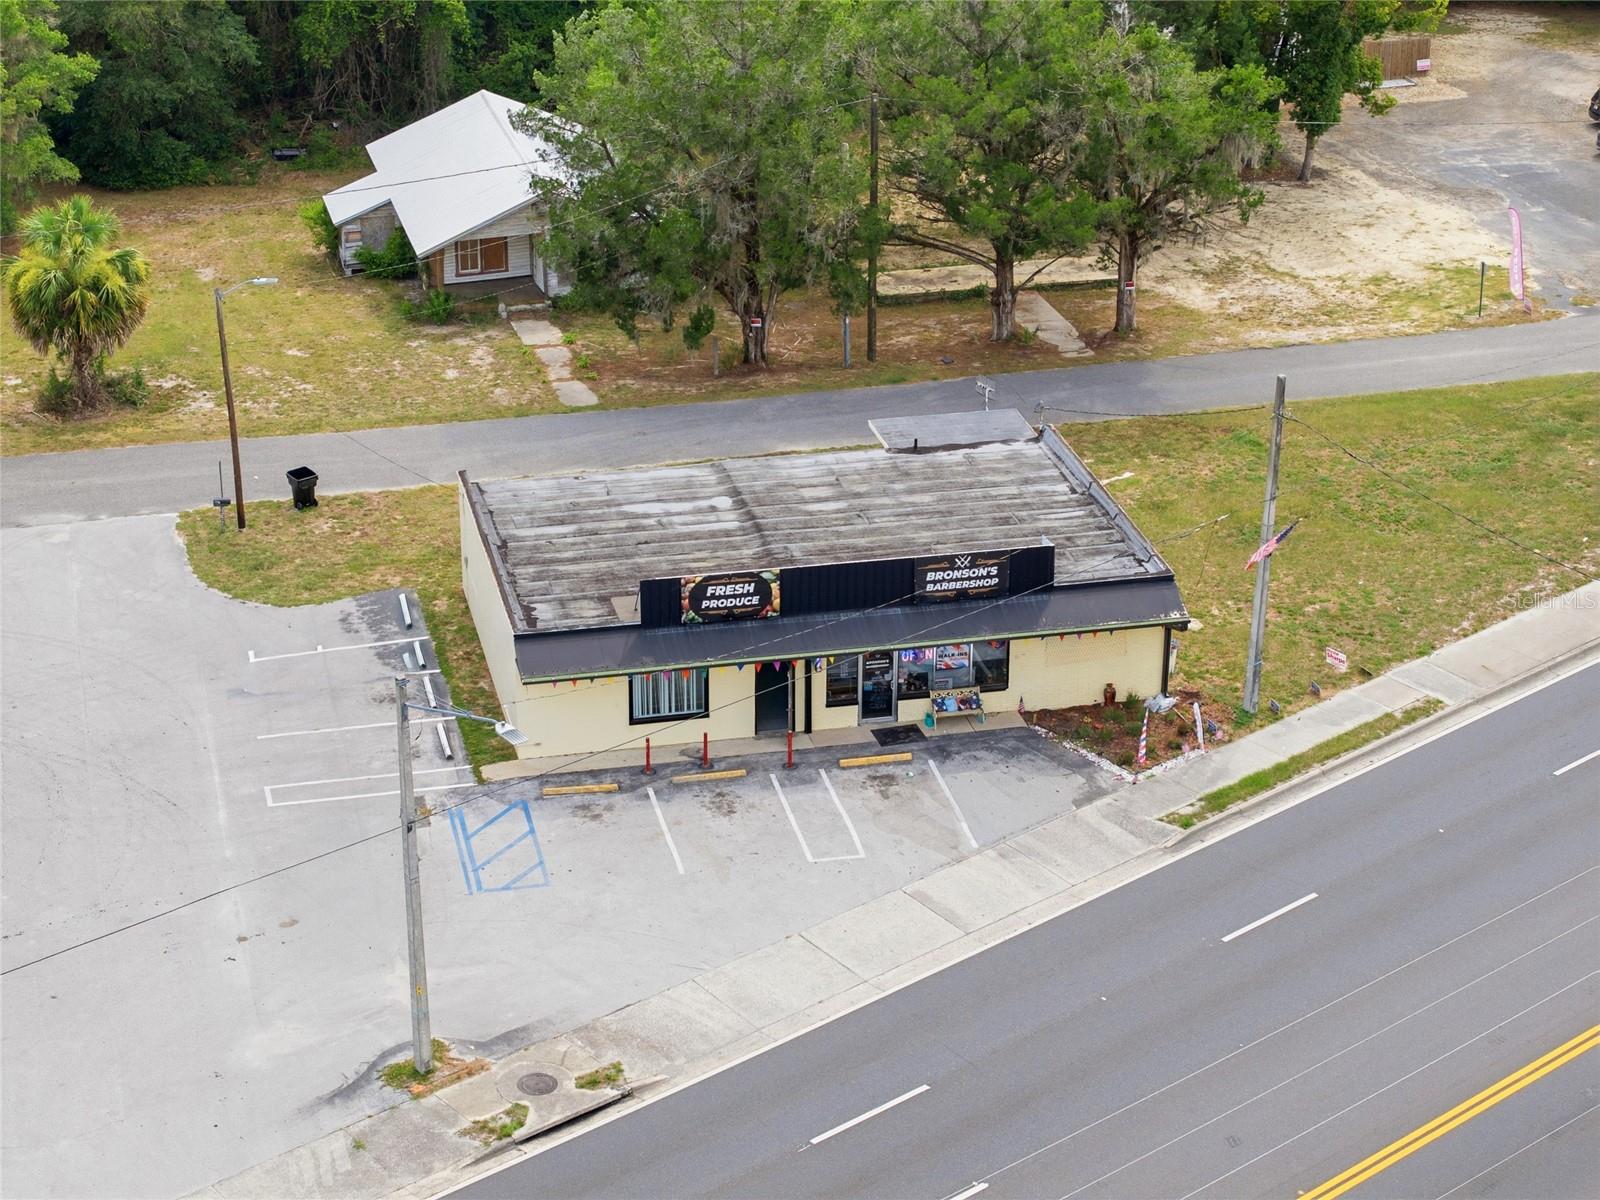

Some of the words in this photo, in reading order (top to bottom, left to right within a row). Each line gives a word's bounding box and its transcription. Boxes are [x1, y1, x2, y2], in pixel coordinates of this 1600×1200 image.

[926, 566, 998, 581] BRONSON'S
[706, 583, 755, 596] FRESH
[926, 578, 999, 592] BARBERSHOP
[701, 596, 760, 609] PRODUCE
